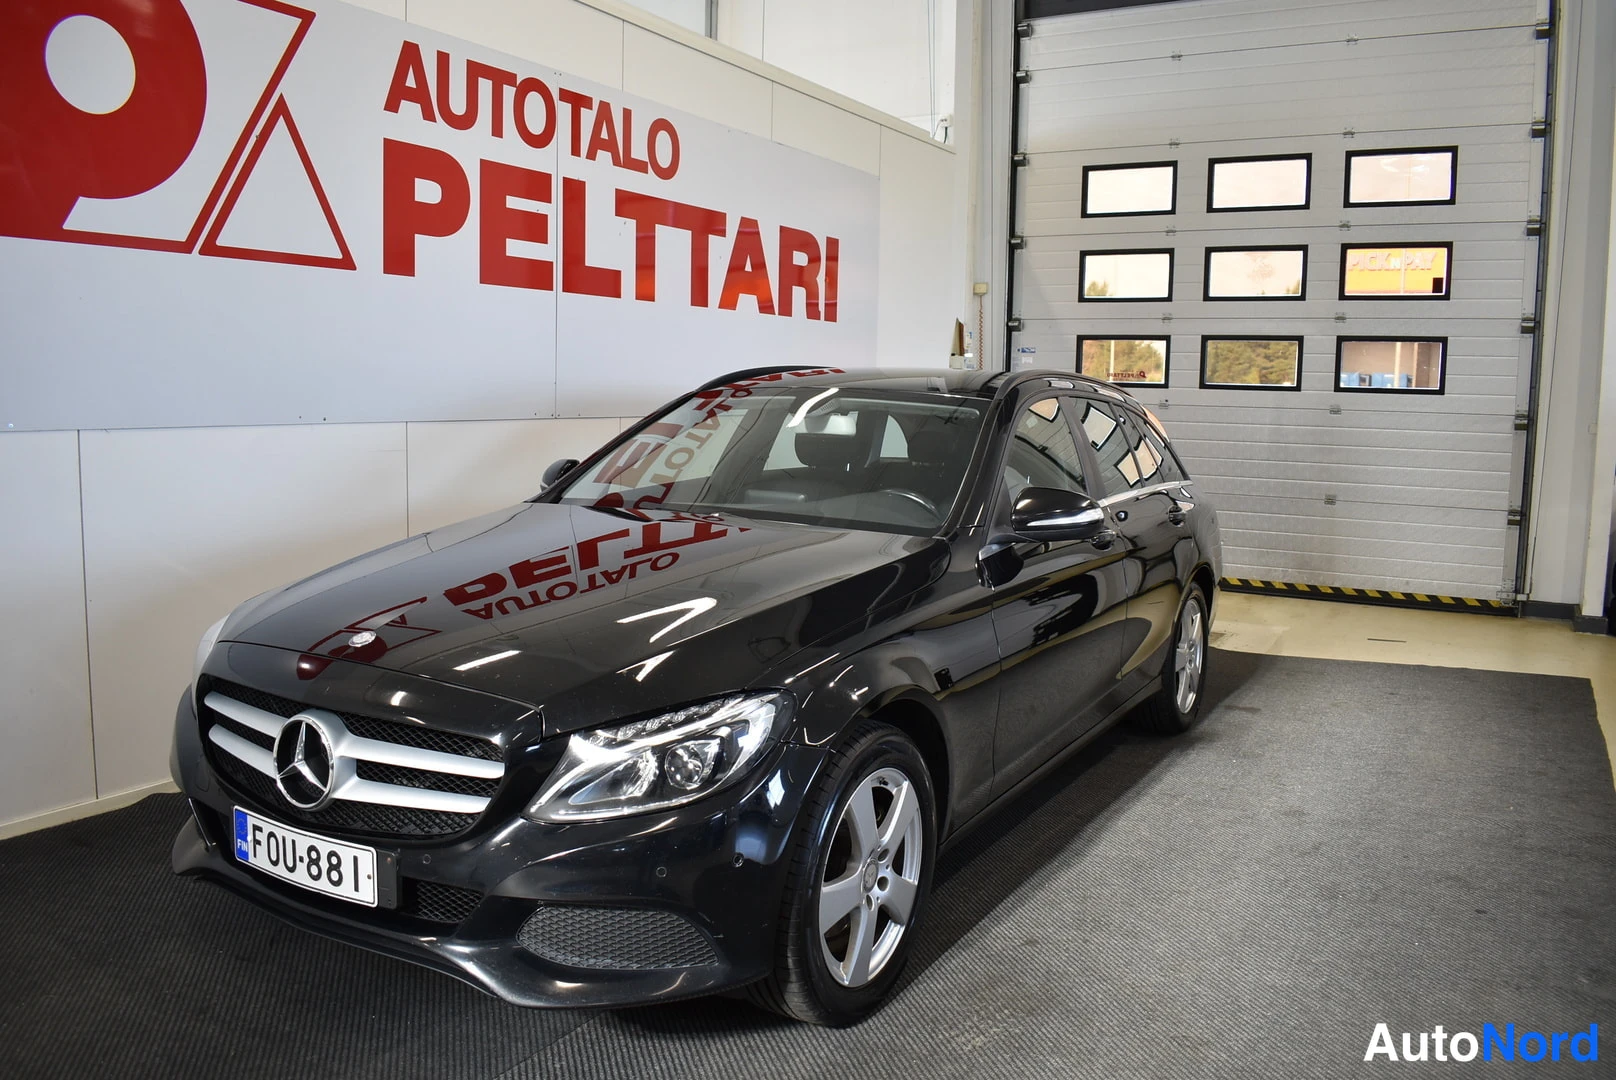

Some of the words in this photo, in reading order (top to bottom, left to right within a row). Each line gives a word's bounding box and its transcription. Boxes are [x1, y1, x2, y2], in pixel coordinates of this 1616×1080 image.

[383, 39, 680, 181] AUTOTALO
[383, 137, 839, 323] PELTTARI
[1348, 251, 1391, 271] PICK
[1404, 250, 1438, 270] PAY
[237, 838, 248, 854] FIN
[252, 823, 360, 893] FOU-881
